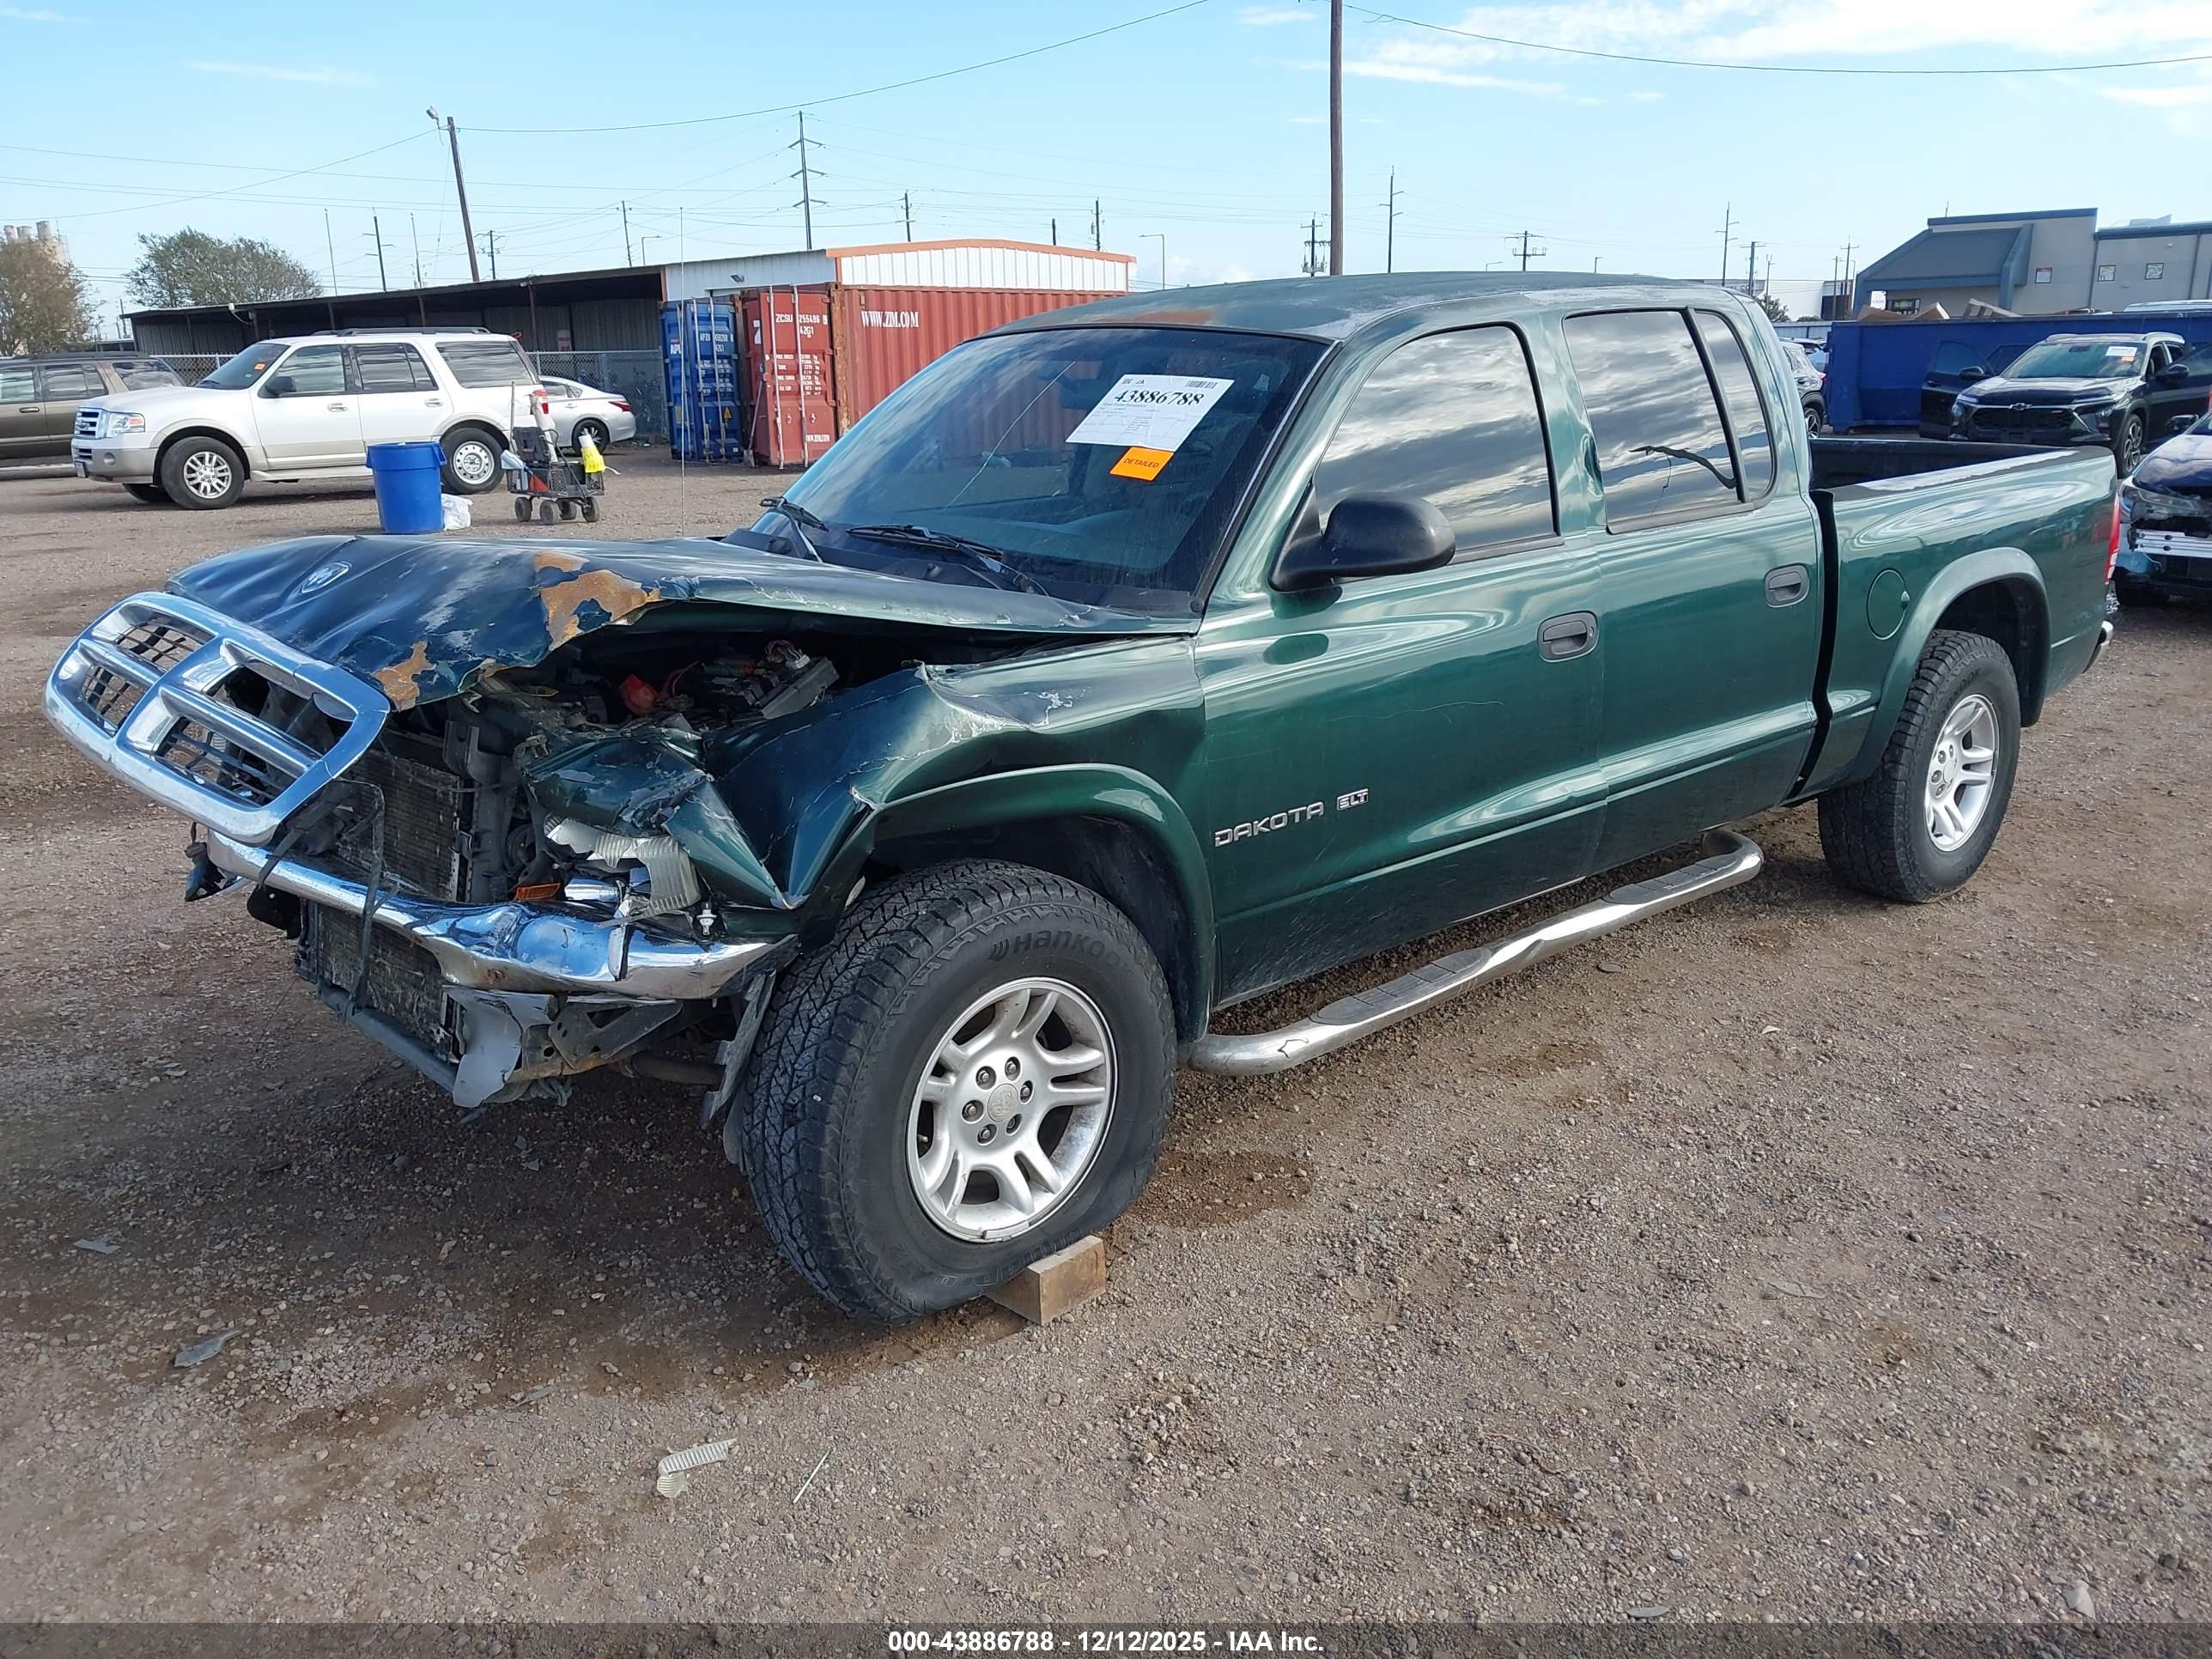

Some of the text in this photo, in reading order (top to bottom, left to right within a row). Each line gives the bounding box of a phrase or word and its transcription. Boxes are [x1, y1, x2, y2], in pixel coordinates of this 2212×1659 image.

[775, 313, 793, 323] ZCSU
[799, 314, 820, 324] 255496
[861, 310, 920, 328] WWW.ZIM.COM
[1115, 389, 1205, 406] 43886788
[1123, 458, 1160, 469] DETAILED
[1214, 789, 1369, 848] DAKOTA SLT
